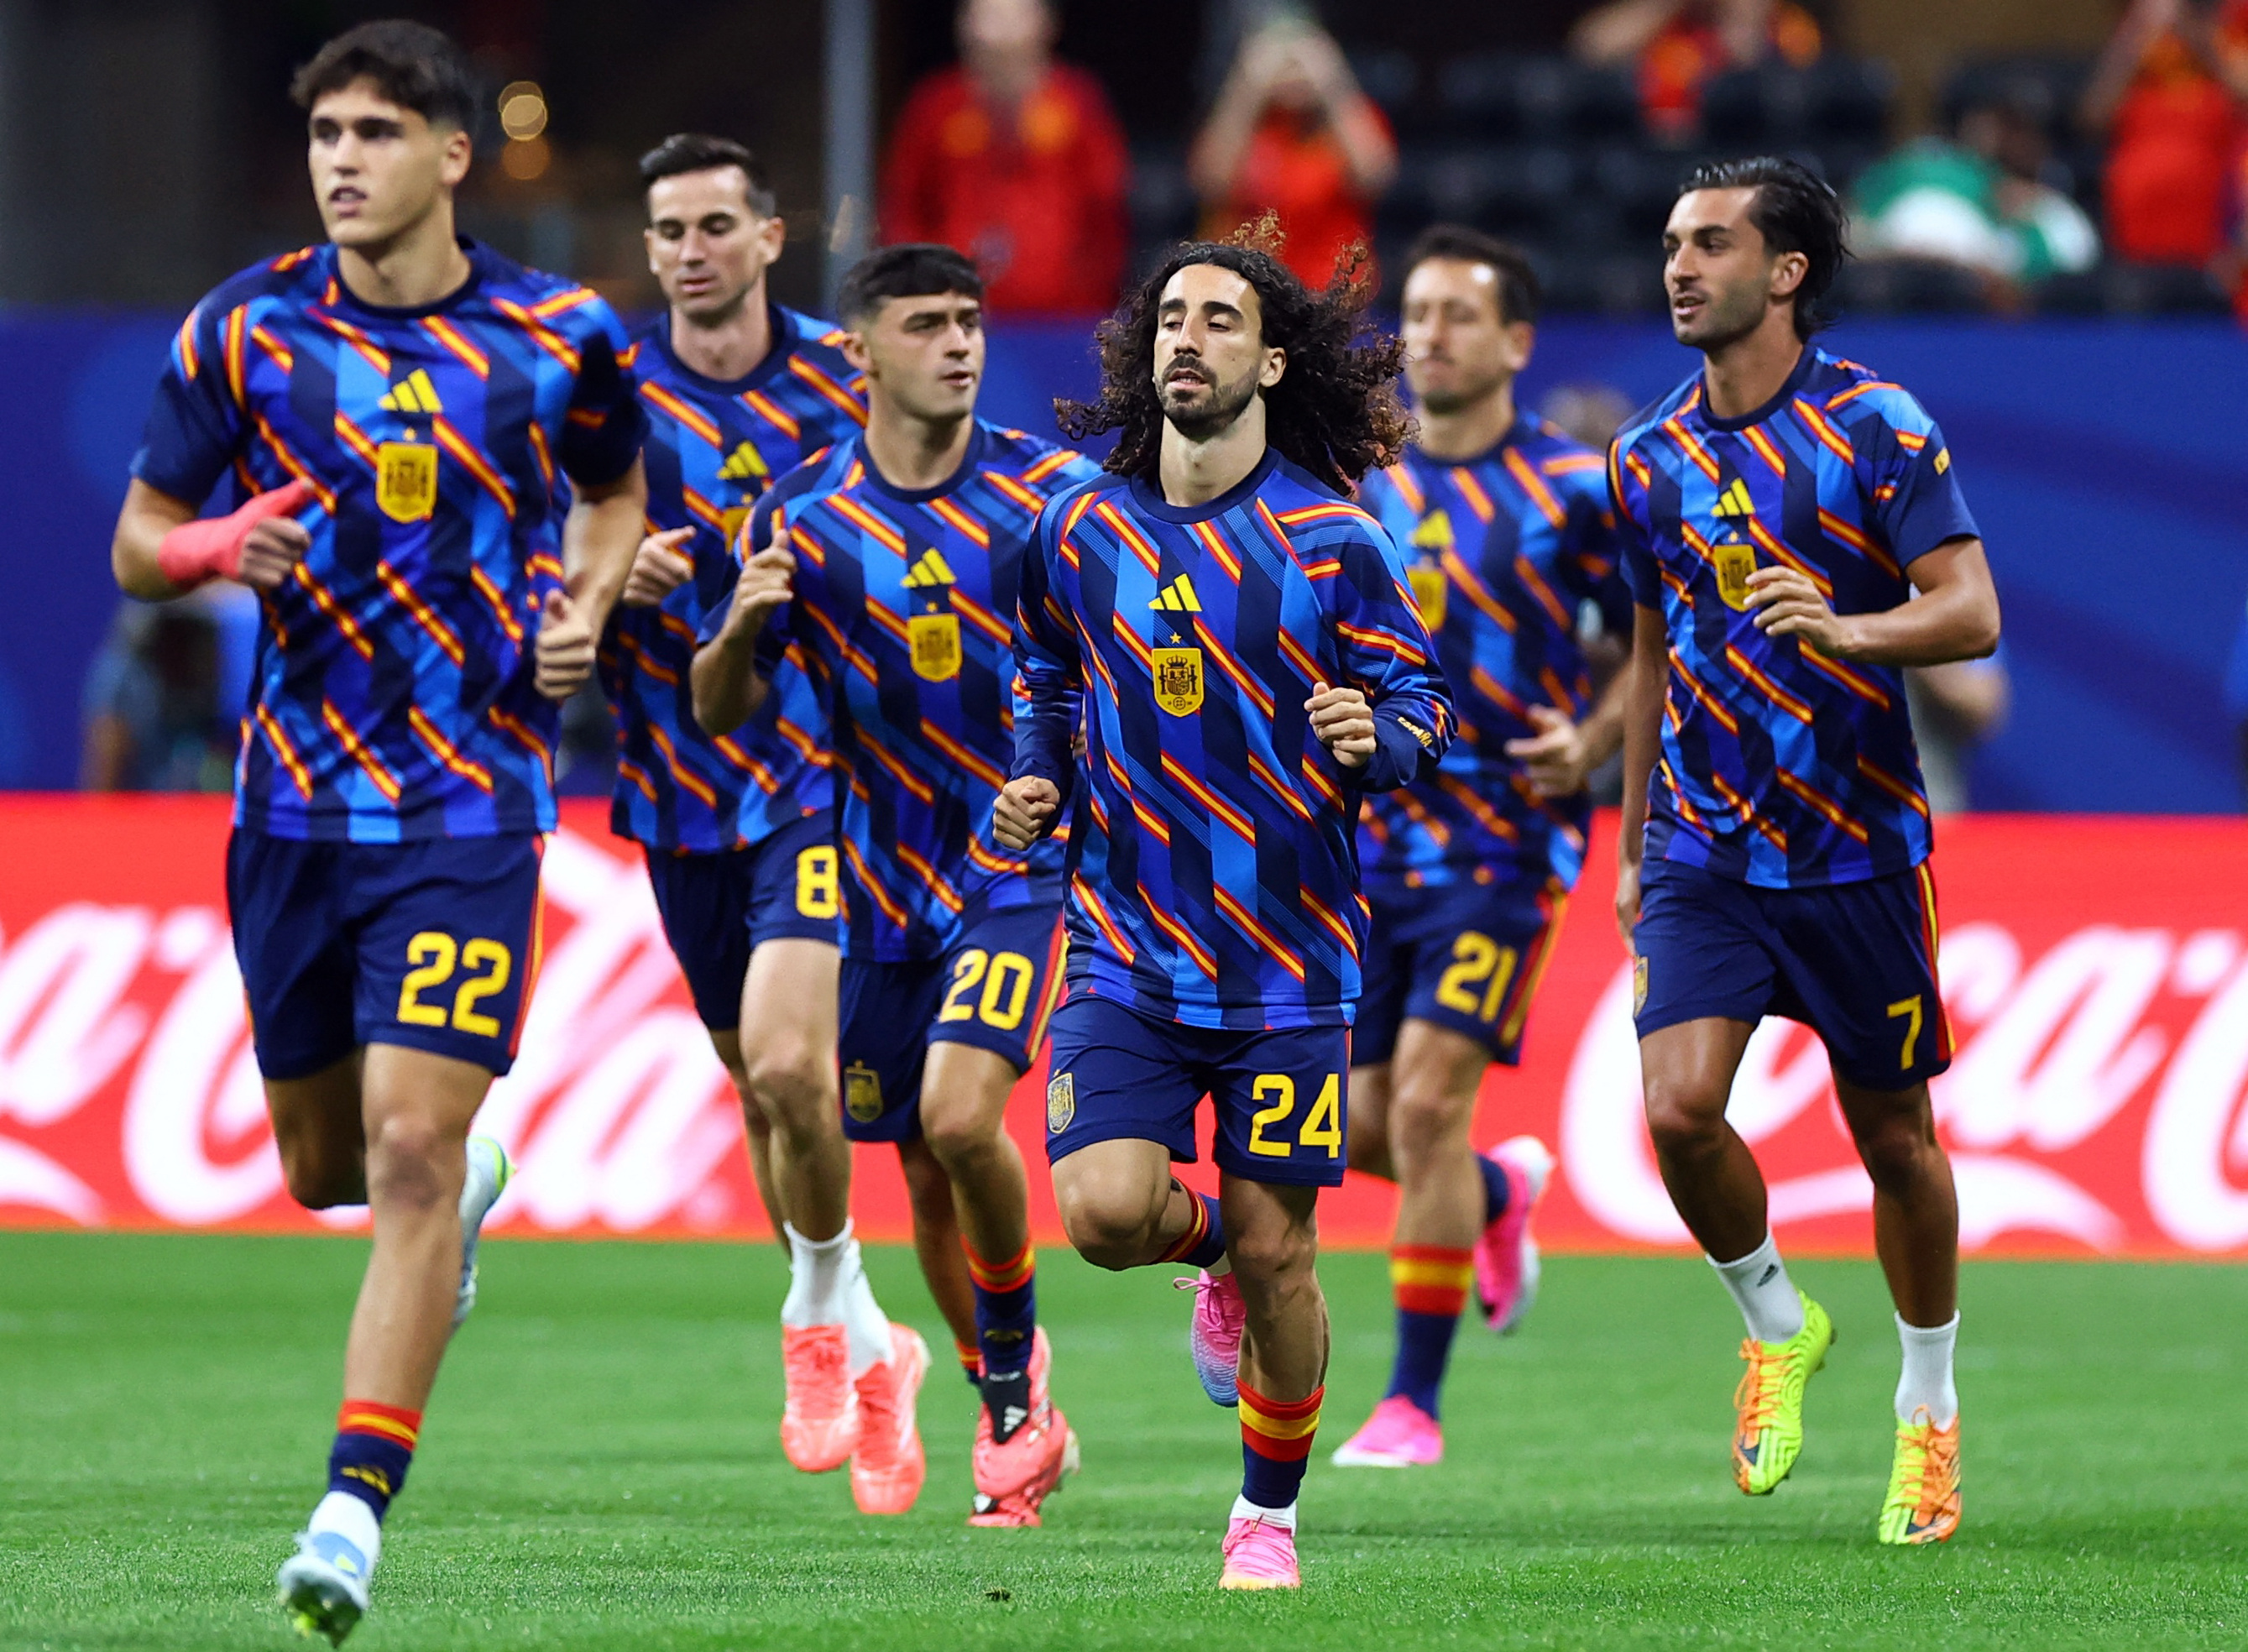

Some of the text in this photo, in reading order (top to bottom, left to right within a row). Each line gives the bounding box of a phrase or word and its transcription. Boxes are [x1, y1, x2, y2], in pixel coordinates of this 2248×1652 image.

[796, 844, 839, 918] 8
[397, 931, 511, 1037] 22
[938, 949, 1034, 1030] 20
[1436, 931, 1517, 1024] 21
[1886, 994, 1923, 1069] 7
[1247, 1073, 1343, 1158] 24
